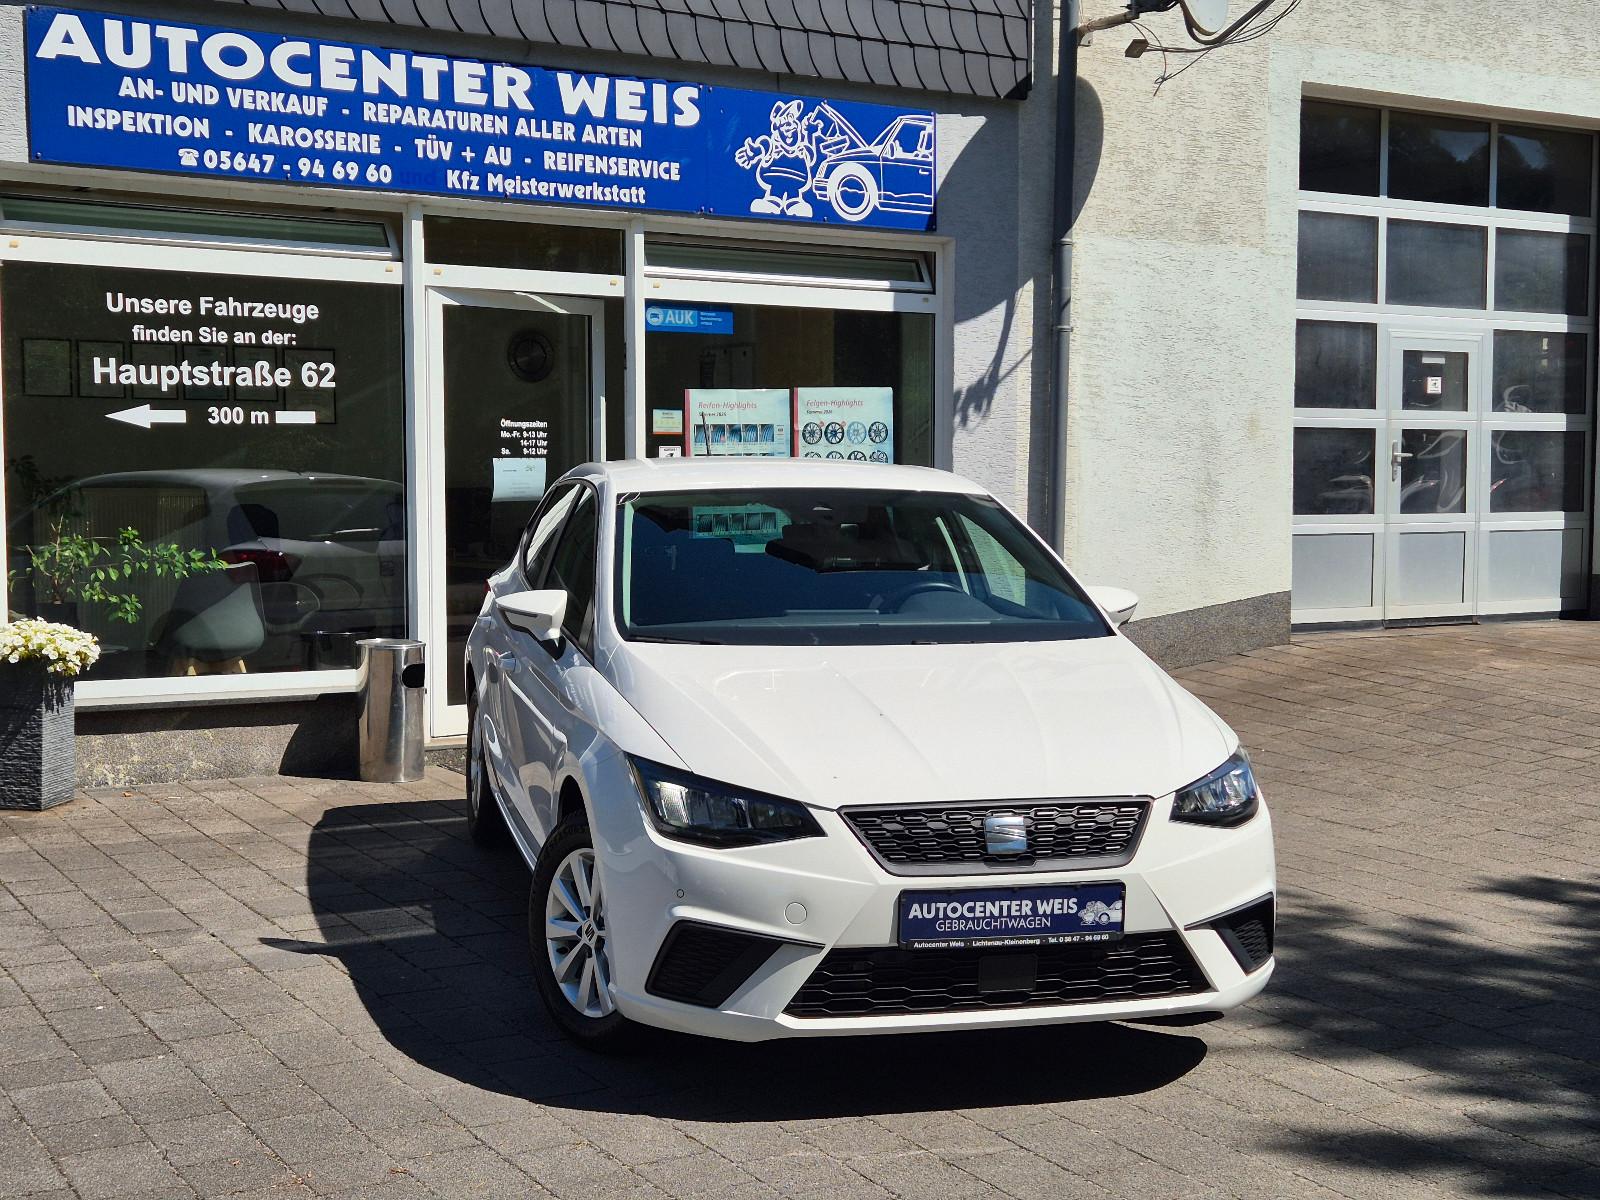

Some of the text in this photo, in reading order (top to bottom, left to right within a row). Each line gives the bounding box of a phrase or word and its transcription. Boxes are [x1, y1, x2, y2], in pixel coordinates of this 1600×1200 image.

[36, 14, 700, 126] AUTOCENTER WEIS
[119, 77, 164, 99] AN-
[172, 82, 219, 105] UND
[226, 88, 328, 117] VERKAUF
[363, 102, 508, 135] REPARATUREN
[515, 117, 575, 142] ALLER
[582, 125, 642, 148] ARTEN
[68, 106, 209, 138] INSPEKTION
[249, 123, 380, 154] KAROSSERIE
[414, 135, 453, 160] TÜV
[484, 146, 511, 166] AU
[544, 151, 681, 181] REIFENSERVICE
[204, 149, 274, 174] 05647
[298, 158, 324, 178] 94
[332, 161, 358, 181] 69
[366, 164, 391, 183] 60
[447, 170, 480, 190] Kfz
[488, 173, 646, 204] Meisterwerkstatt
[106, 291, 320, 323] Unsere Fahrzeuge
[665, 309, 694, 325] AUK
[132, 324, 297, 345] finden Sie an der:
[93, 357, 336, 392] Hauptstraße 62
[207, 406, 269, 425] 300 m
[500, 418, 548, 429] Öffnungszeiten
[908, 897, 1078, 919] AUTOCENTER WEIS
[935, 916, 1051, 932] GEBRAUCHTWAGEN
